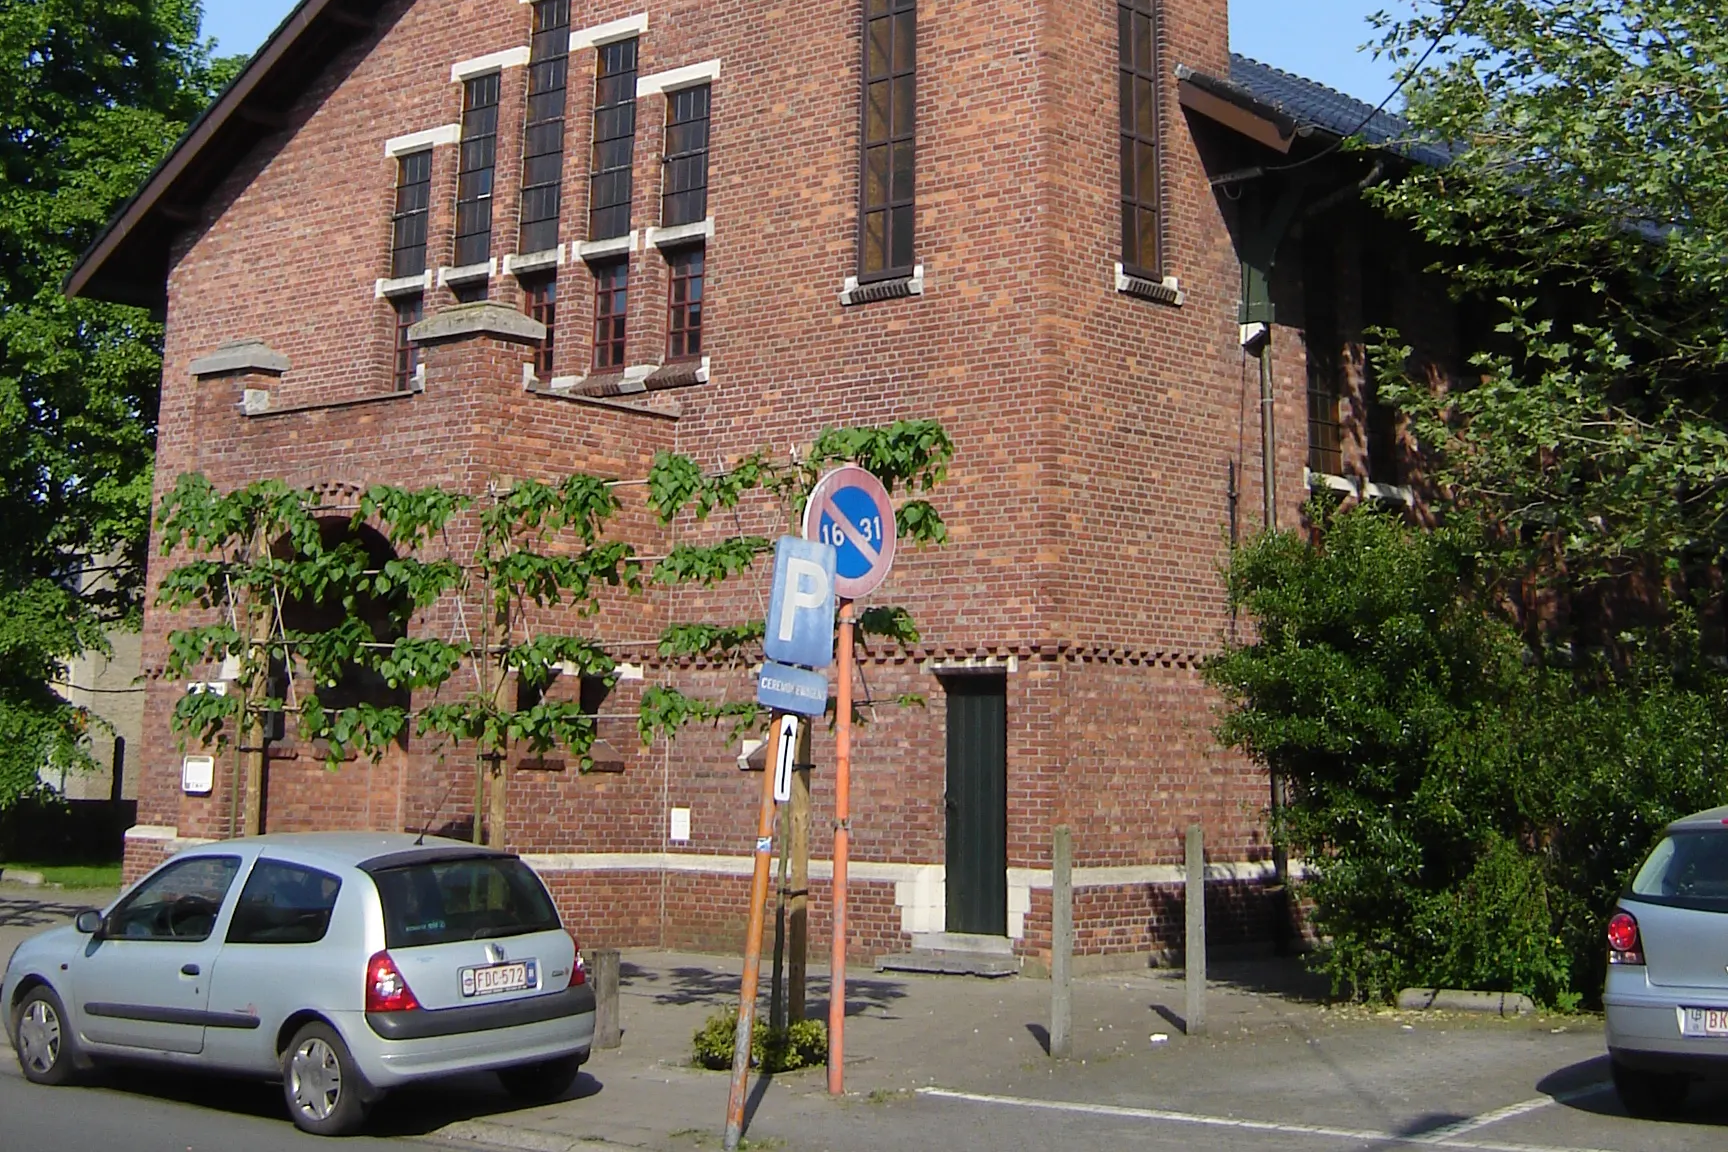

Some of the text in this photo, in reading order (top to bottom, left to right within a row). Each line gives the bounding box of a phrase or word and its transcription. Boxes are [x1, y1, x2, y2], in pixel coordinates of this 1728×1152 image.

[822, 516, 881, 547] 16 31
[778, 557, 828, 642] P
